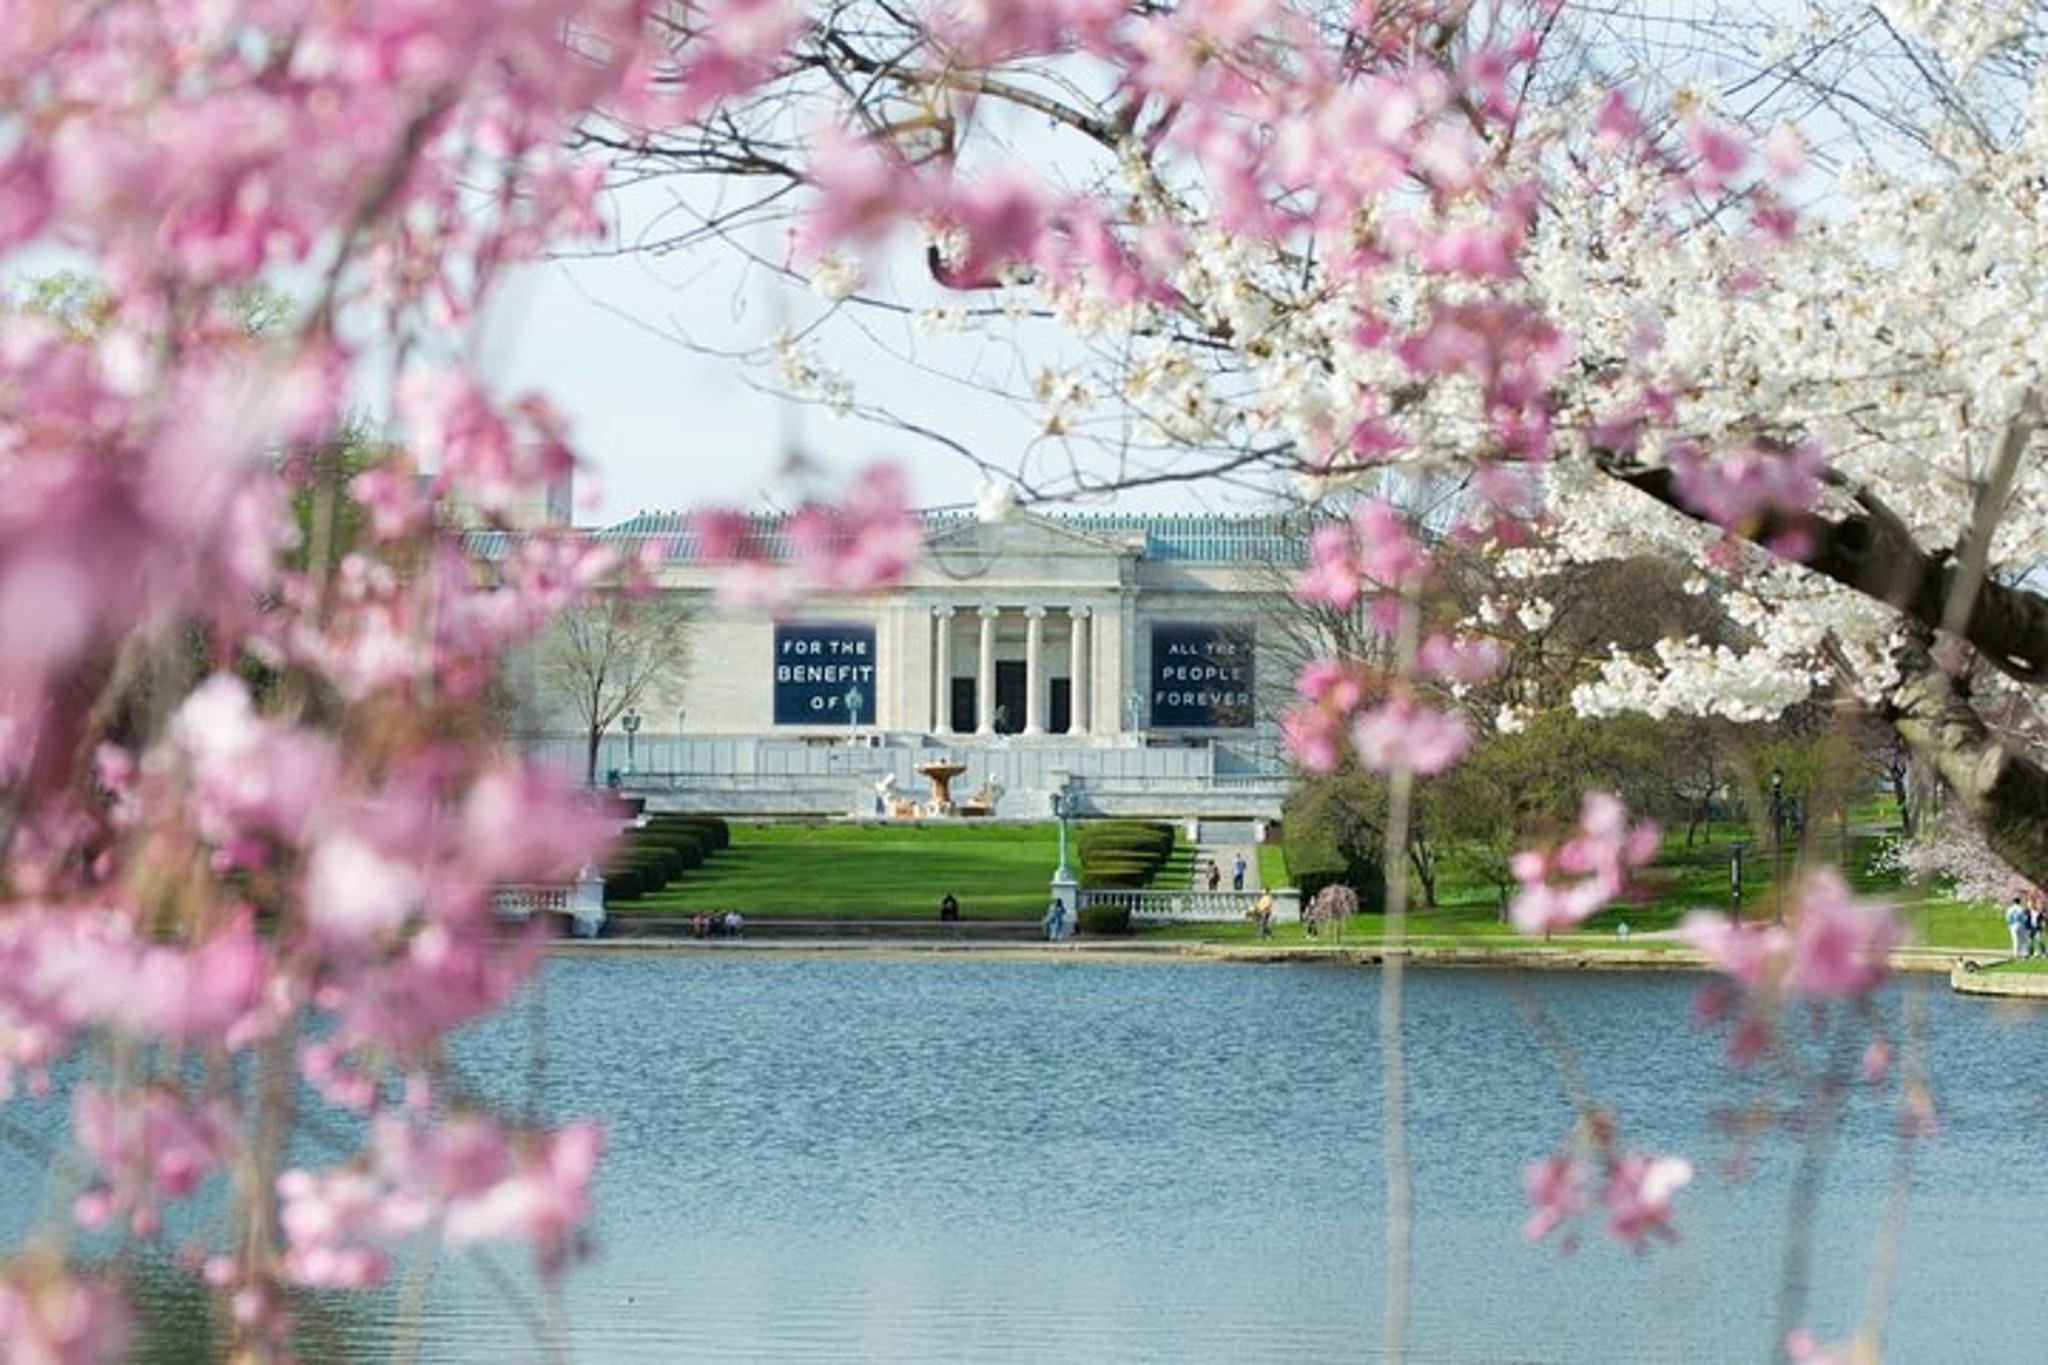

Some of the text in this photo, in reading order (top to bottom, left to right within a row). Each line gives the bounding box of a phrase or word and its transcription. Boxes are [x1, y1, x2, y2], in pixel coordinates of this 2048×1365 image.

[783, 641, 866, 655] FOR THE
[1168, 644, 1198, 655] ALL
[778, 664, 873, 683] BENEFIT
[1162, 666, 1241, 681] PEOPLE
[810, 695, 838, 710] OF
[1156, 691, 1249, 706] FOREVER
